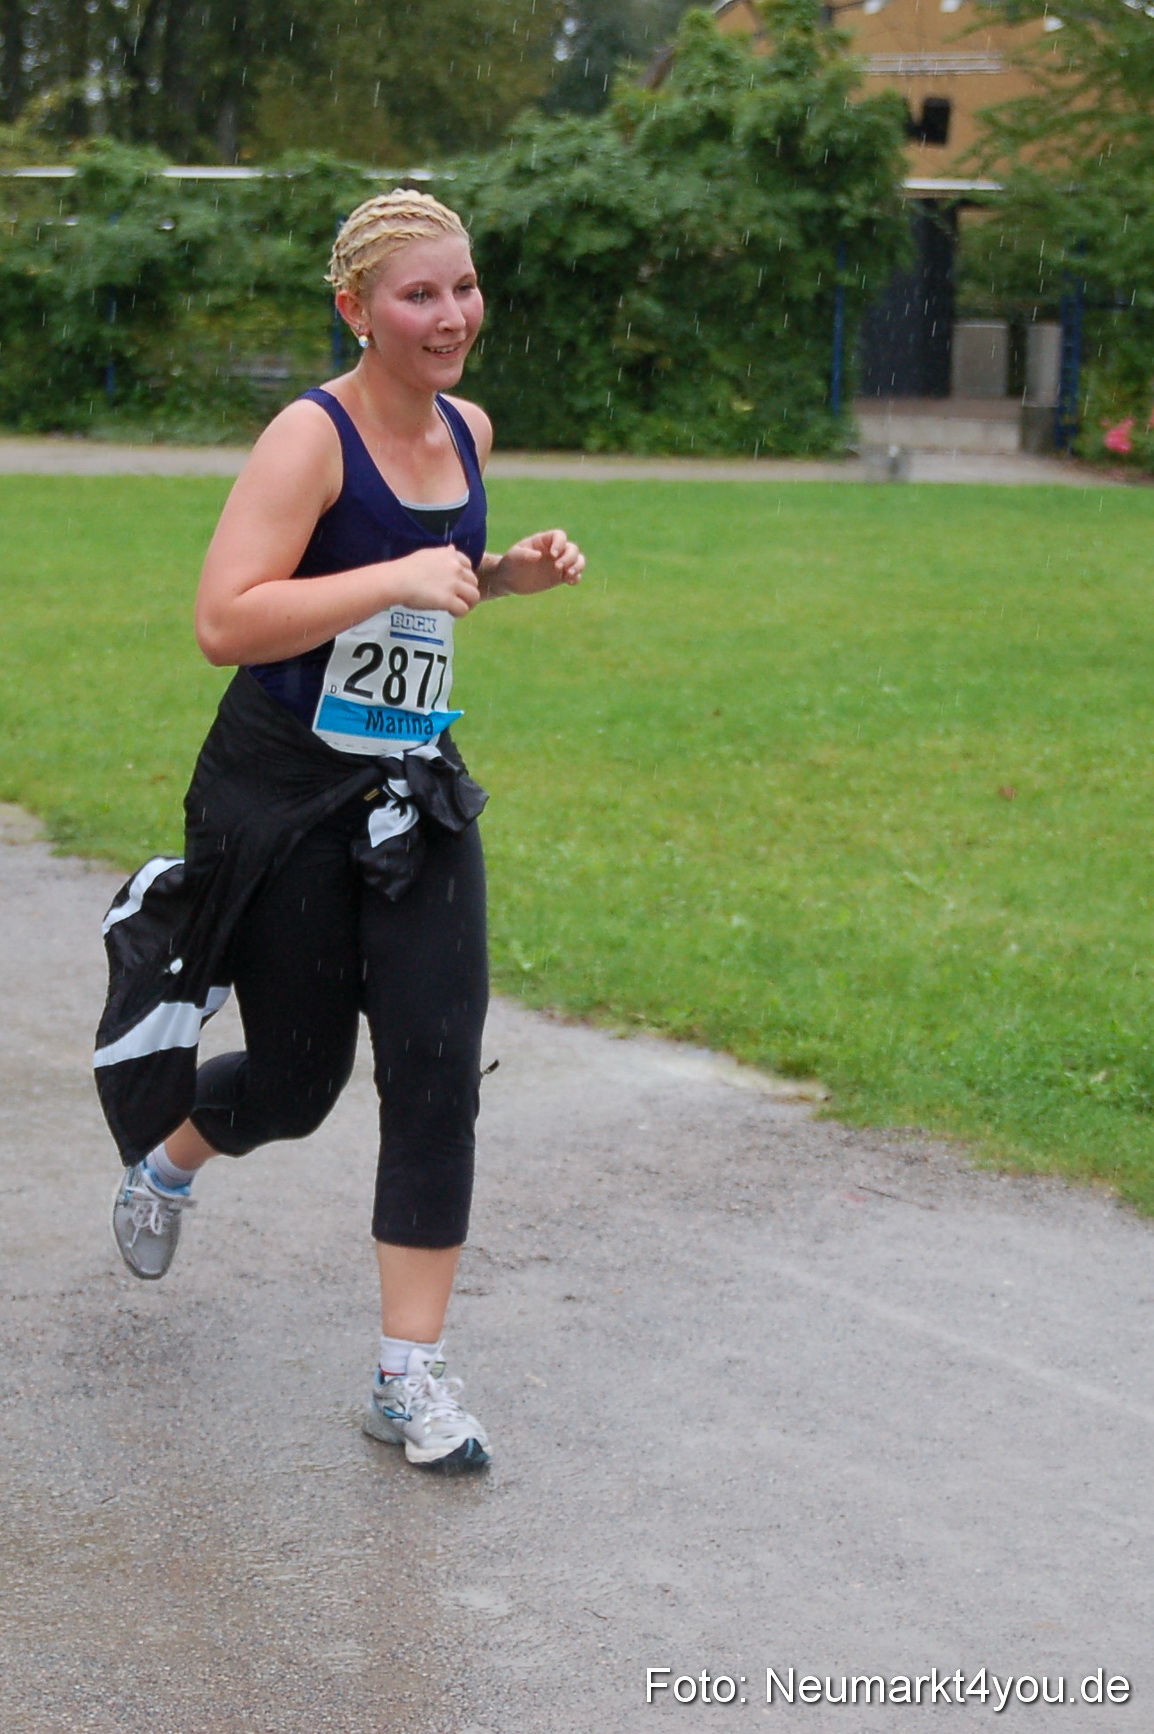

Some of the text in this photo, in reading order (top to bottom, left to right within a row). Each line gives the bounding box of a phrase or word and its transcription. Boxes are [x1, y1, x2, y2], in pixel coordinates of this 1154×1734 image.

[390, 612, 437, 633] BOCK
[343, 642, 448, 710] 2877
[330, 684, 338, 695] D
[365, 710, 434, 736] Marina
